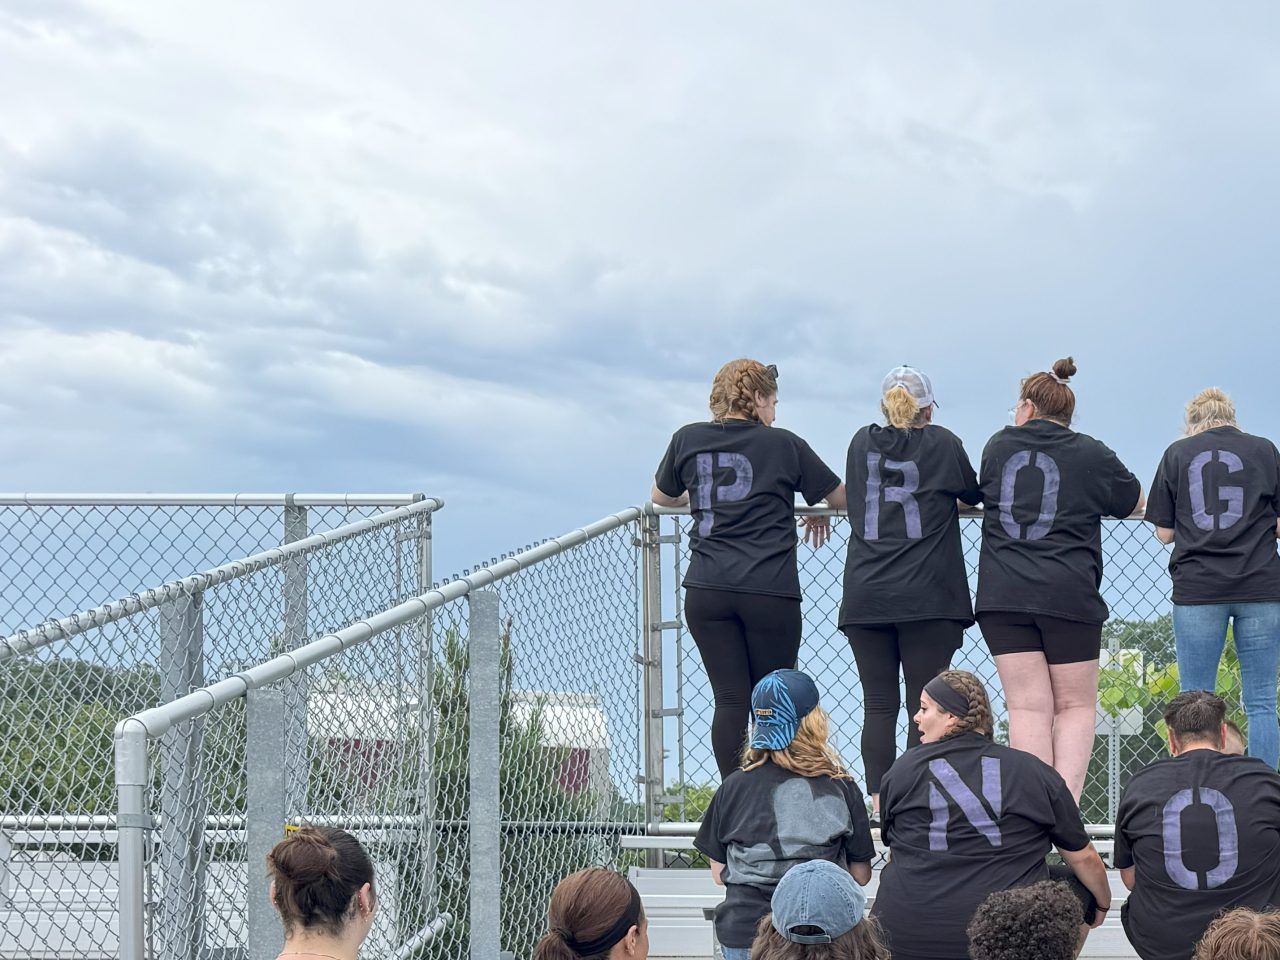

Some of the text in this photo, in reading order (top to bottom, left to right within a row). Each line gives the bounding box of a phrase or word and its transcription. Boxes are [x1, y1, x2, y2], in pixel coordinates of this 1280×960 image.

[696, 452, 753, 537] P
[864, 451, 923, 540] R
[999, 449, 1061, 540] O
[1187, 449, 1246, 530] G
[929, 757, 1003, 851] N
[1162, 787, 1239, 890] O
